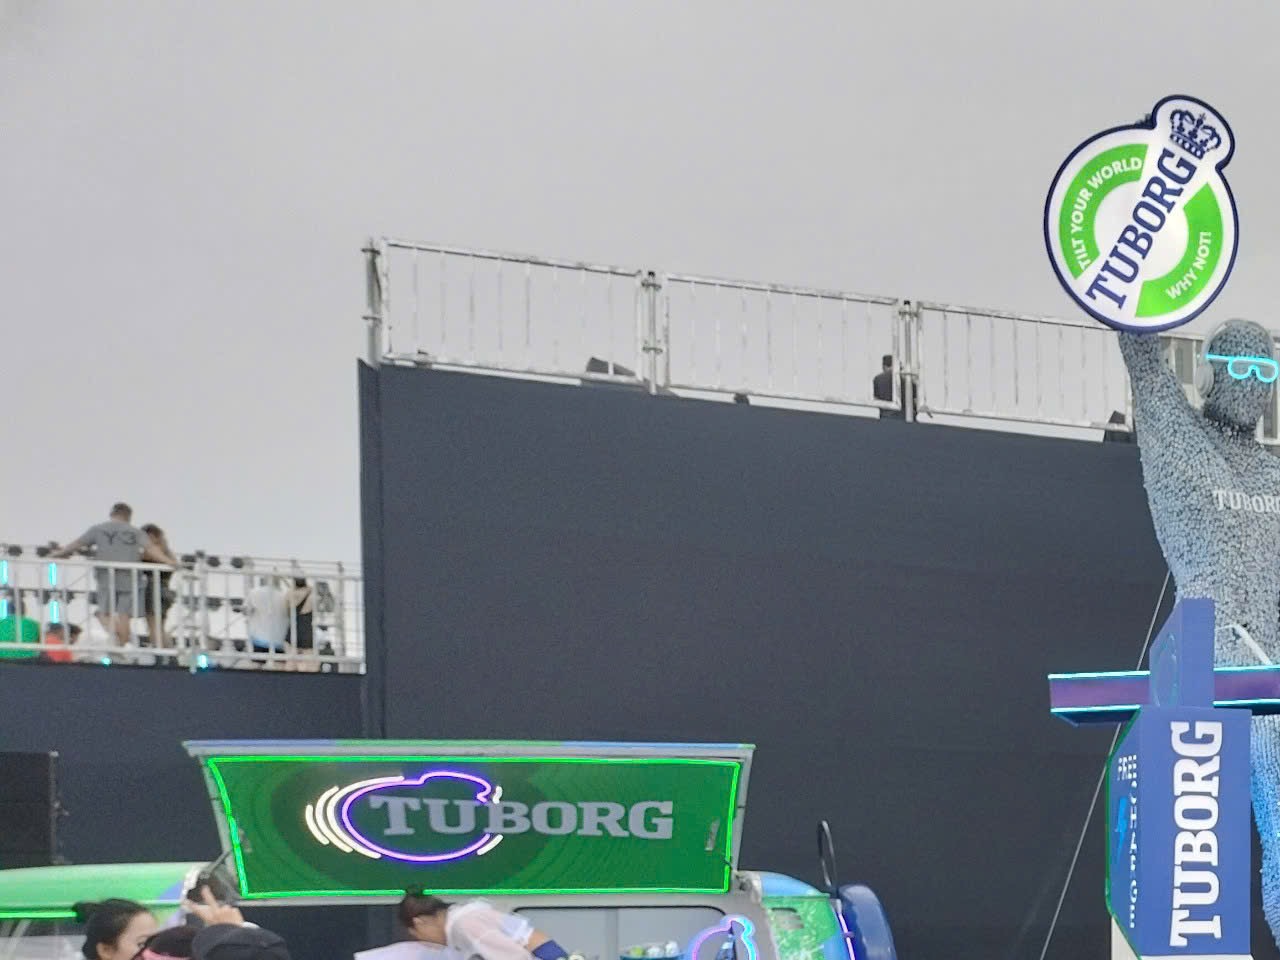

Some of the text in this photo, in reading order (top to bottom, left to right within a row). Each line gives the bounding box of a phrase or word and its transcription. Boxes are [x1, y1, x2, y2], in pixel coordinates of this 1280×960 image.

[1070, 157, 1142, 270] TILT YOUR WORLD
[1085, 147, 1198, 309] TUBORG
[1165, 231, 1212, 300] WHY NOT!
[369, 794, 673, 840] TUBORG
[1170, 721, 1223, 947] TUBORG
